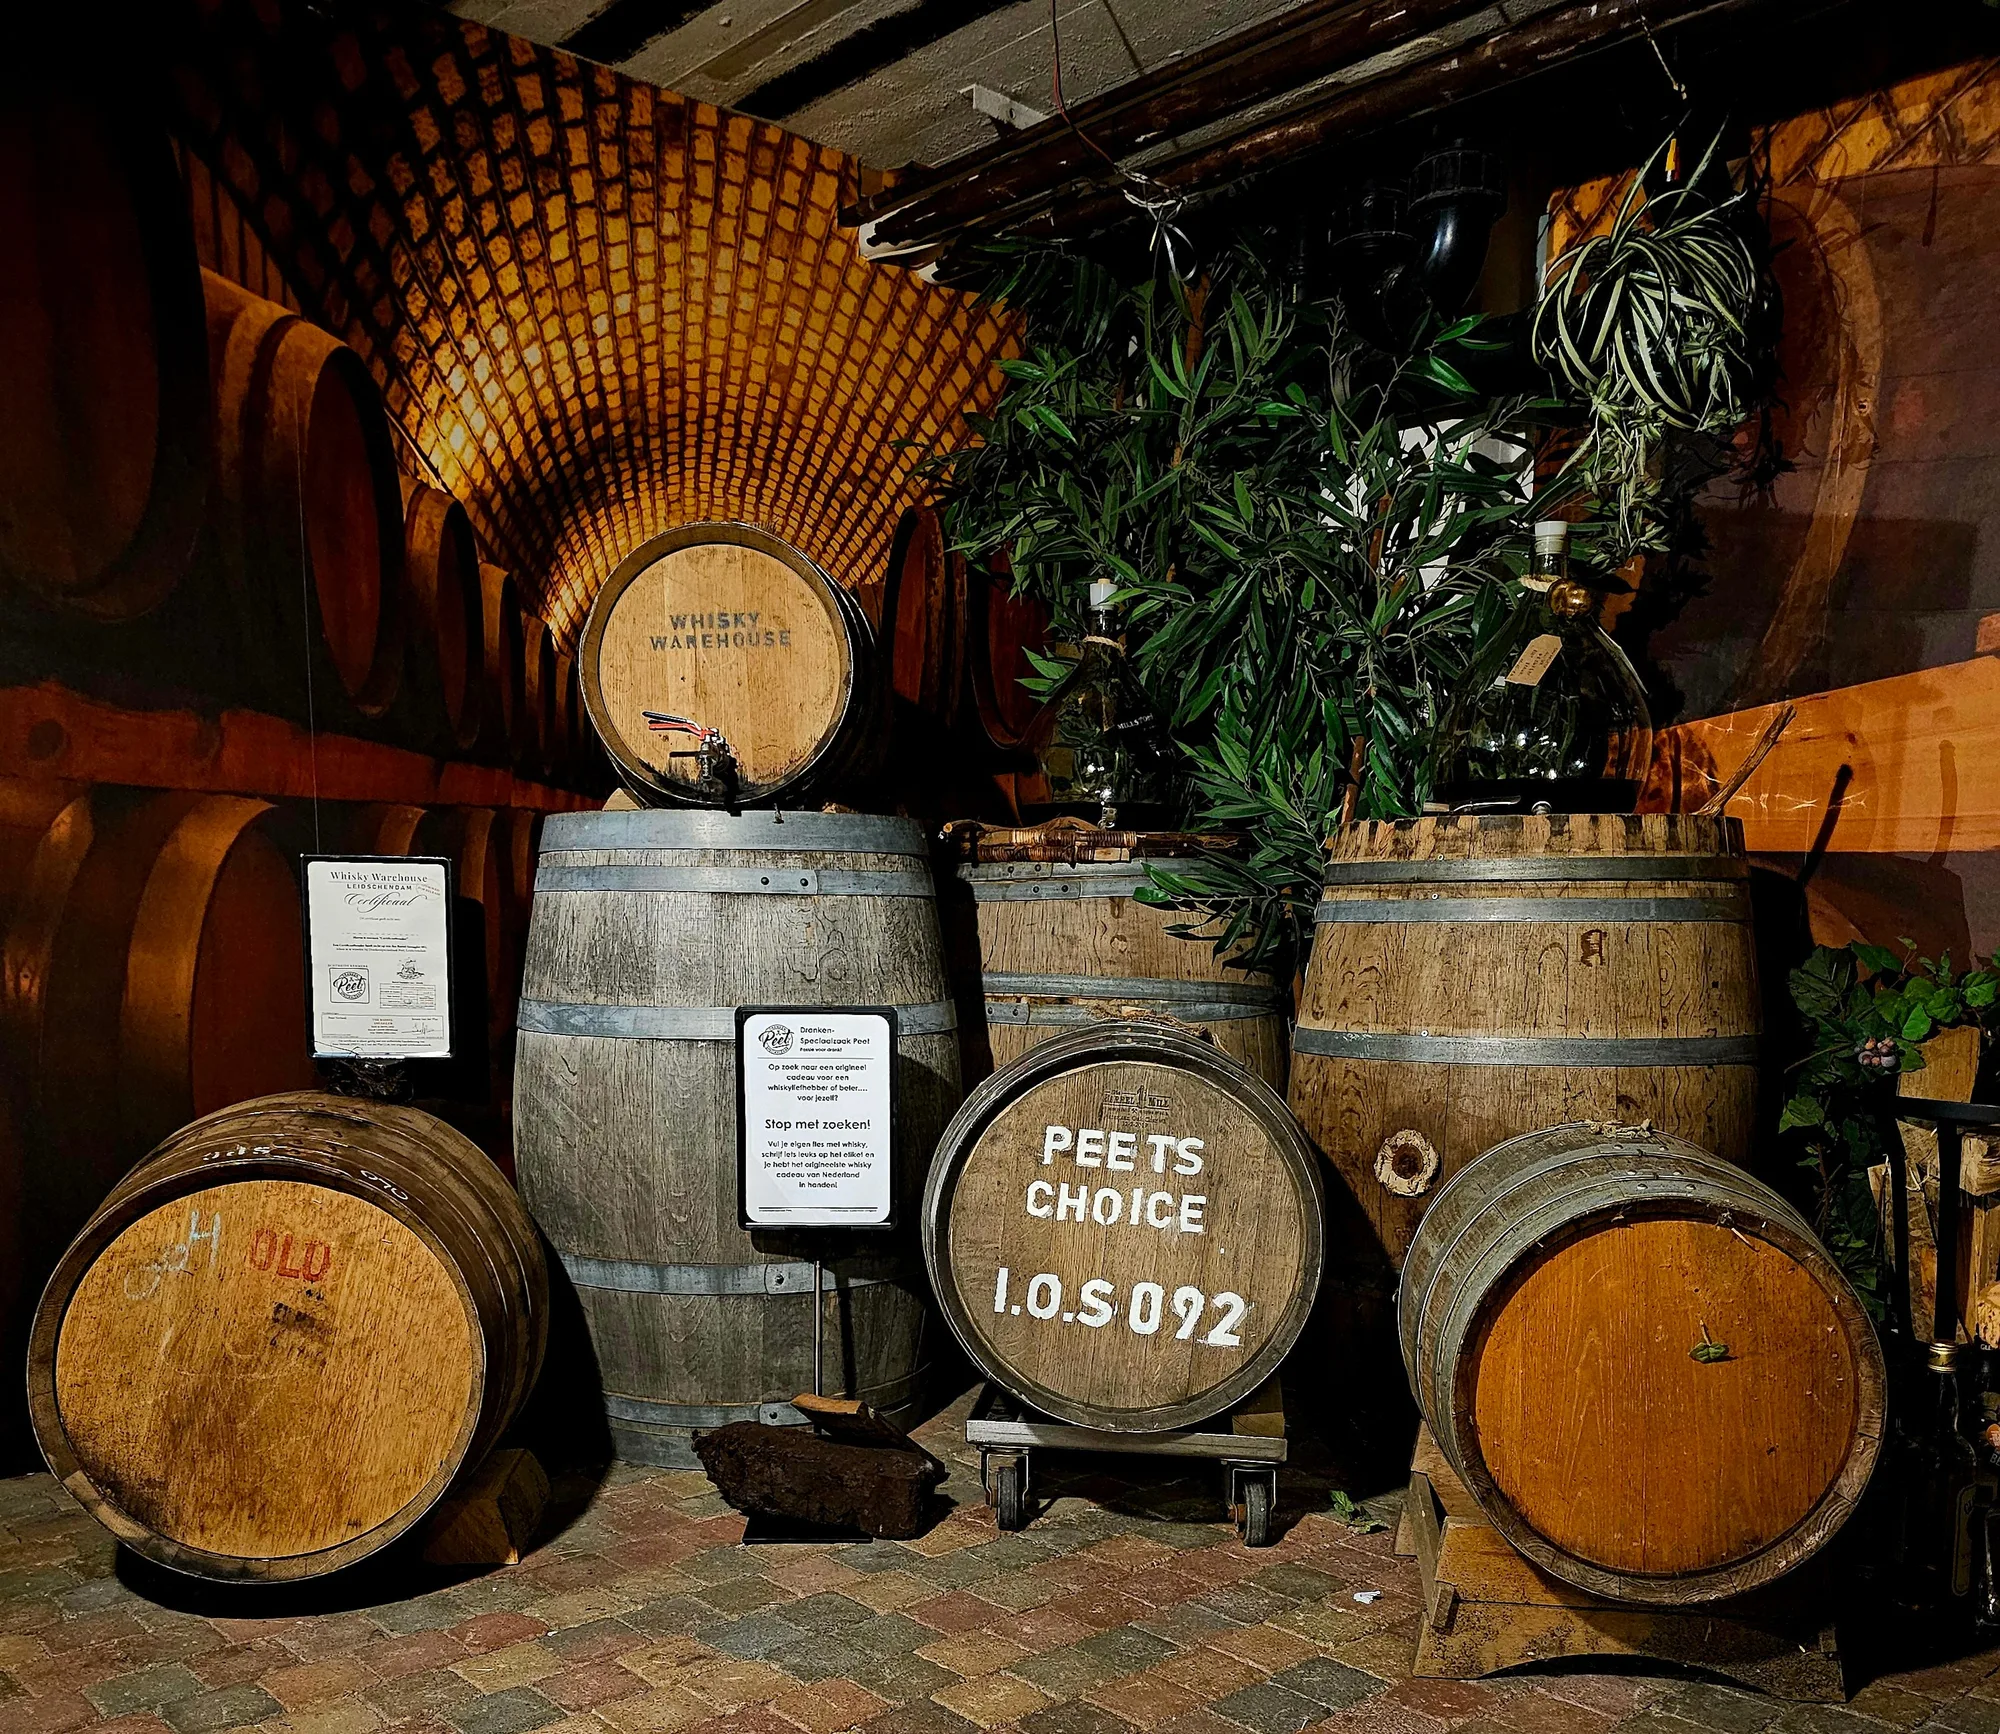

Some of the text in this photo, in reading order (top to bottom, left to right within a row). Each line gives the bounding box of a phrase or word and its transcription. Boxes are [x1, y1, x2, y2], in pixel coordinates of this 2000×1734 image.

[669, 612, 760, 630] WHISKY
[650, 629, 791, 651] WAREHOUSE
[331, 871, 428, 882] Whisky Warehouse
[333, 976, 366, 992] Peet
[758, 1029, 794, 1047] Peet
[835, 1064, 866, 1072] origineel
[765, 1119, 871, 1131] Stop met zoeken!
[781, 1141, 788, 1149] je
[790, 1141, 811, 1149] eigen
[1025, 1180, 1207, 1234] CHOICE
